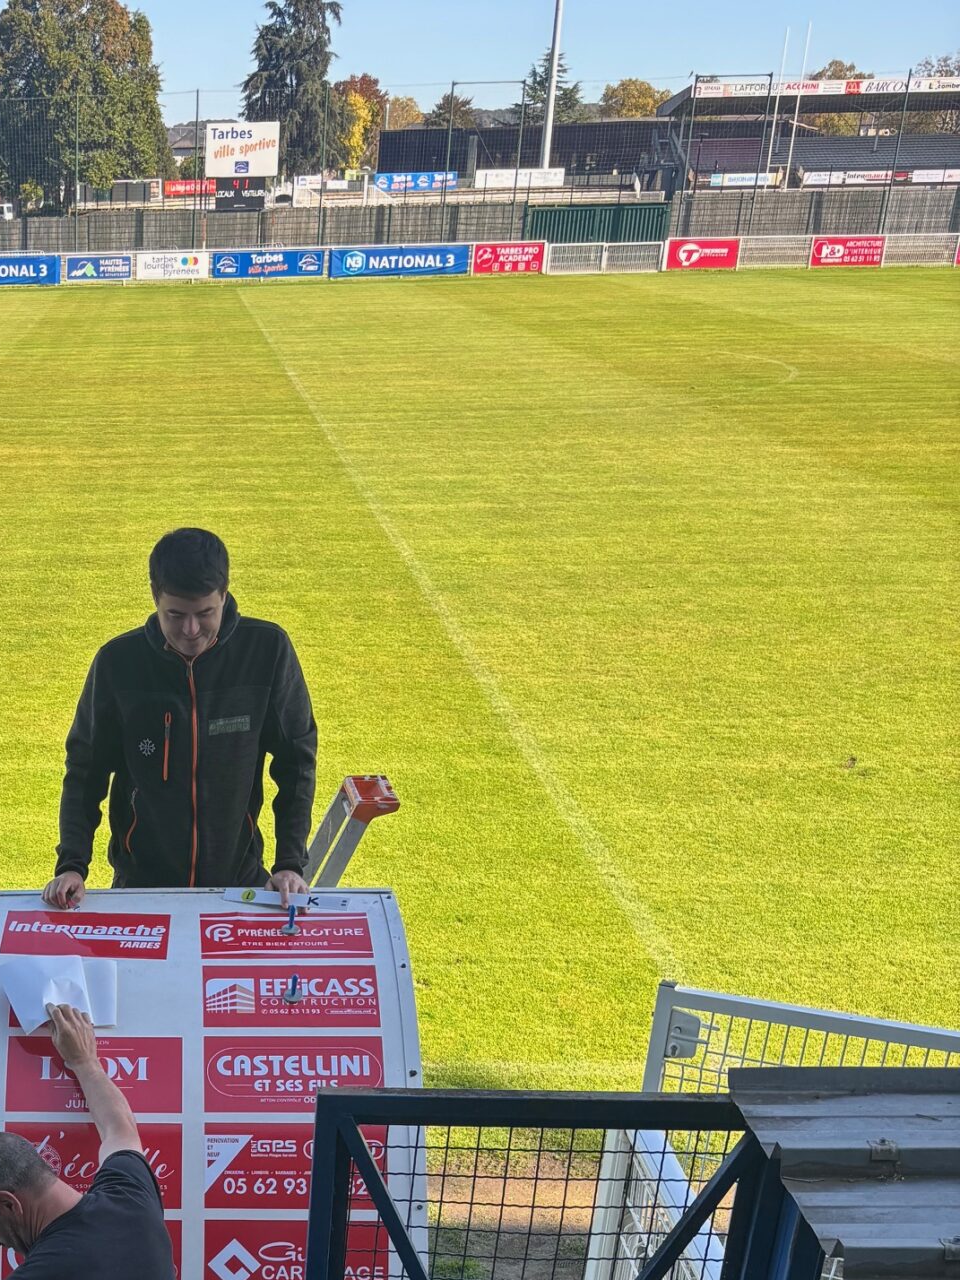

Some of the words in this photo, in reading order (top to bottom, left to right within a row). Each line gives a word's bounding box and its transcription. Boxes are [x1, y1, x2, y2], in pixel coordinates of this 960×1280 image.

[211, 127, 253, 139] Tarbes
[214, 145, 235, 159] ville
[239, 138, 276, 157] sportive
[215, 190, 235, 198] LOCAUX
[496, 246, 523, 255] TARBES
[524, 246, 539, 254] PRO
[250, 253, 284, 264] Tarbes
[346, 258, 361, 268] N3
[369, 254, 443, 270] NATIONAL
[445, 254, 455, 266] 3
[498, 254, 534, 262] ACADEMY
[38, 264, 48, 276] 3
[144, 261, 174, 270] lourdes
[307, 896, 320, 906] K
[8, 920, 167, 939] Intermarché
[119, 941, 161, 949] TARBES
[216, 1055, 370, 1076] CASTELLINI
[254, 1079, 272, 1091] ET
[276, 1079, 304, 1091] SES
[257, 1139, 297, 1153] GPS
[223, 1178, 247, 1195] 05
[253, 1178, 277, 1195] 62
[283, 1178, 308, 1195] 93
